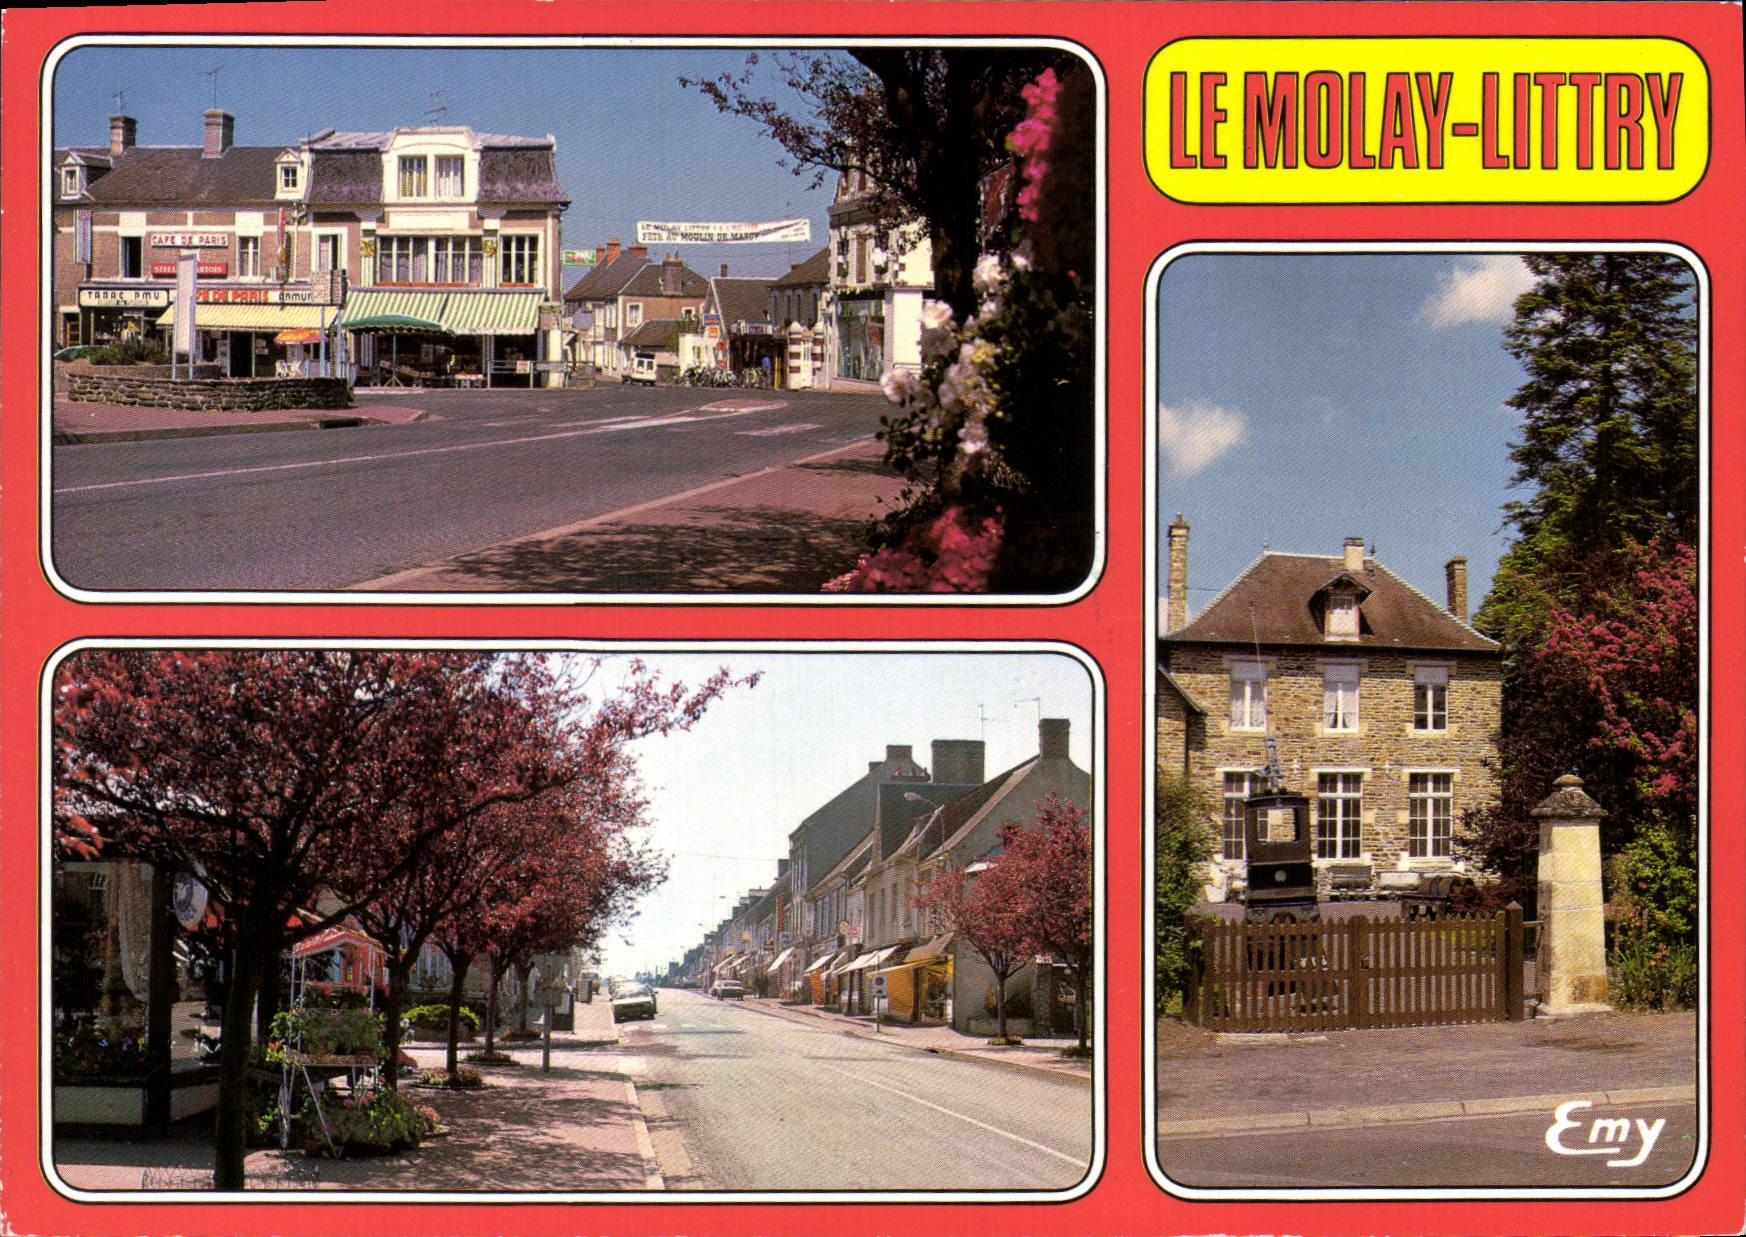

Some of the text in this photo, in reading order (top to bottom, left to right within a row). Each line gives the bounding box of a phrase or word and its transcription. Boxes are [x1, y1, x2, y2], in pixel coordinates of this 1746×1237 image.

[152, 235, 227, 245] CAFE DE PARIS
[681, 232, 714, 242] MOULIN
[716, 232, 728, 241] DE
[153, 265, 178, 273] STELL
[231, 288, 269, 301] PARIS
